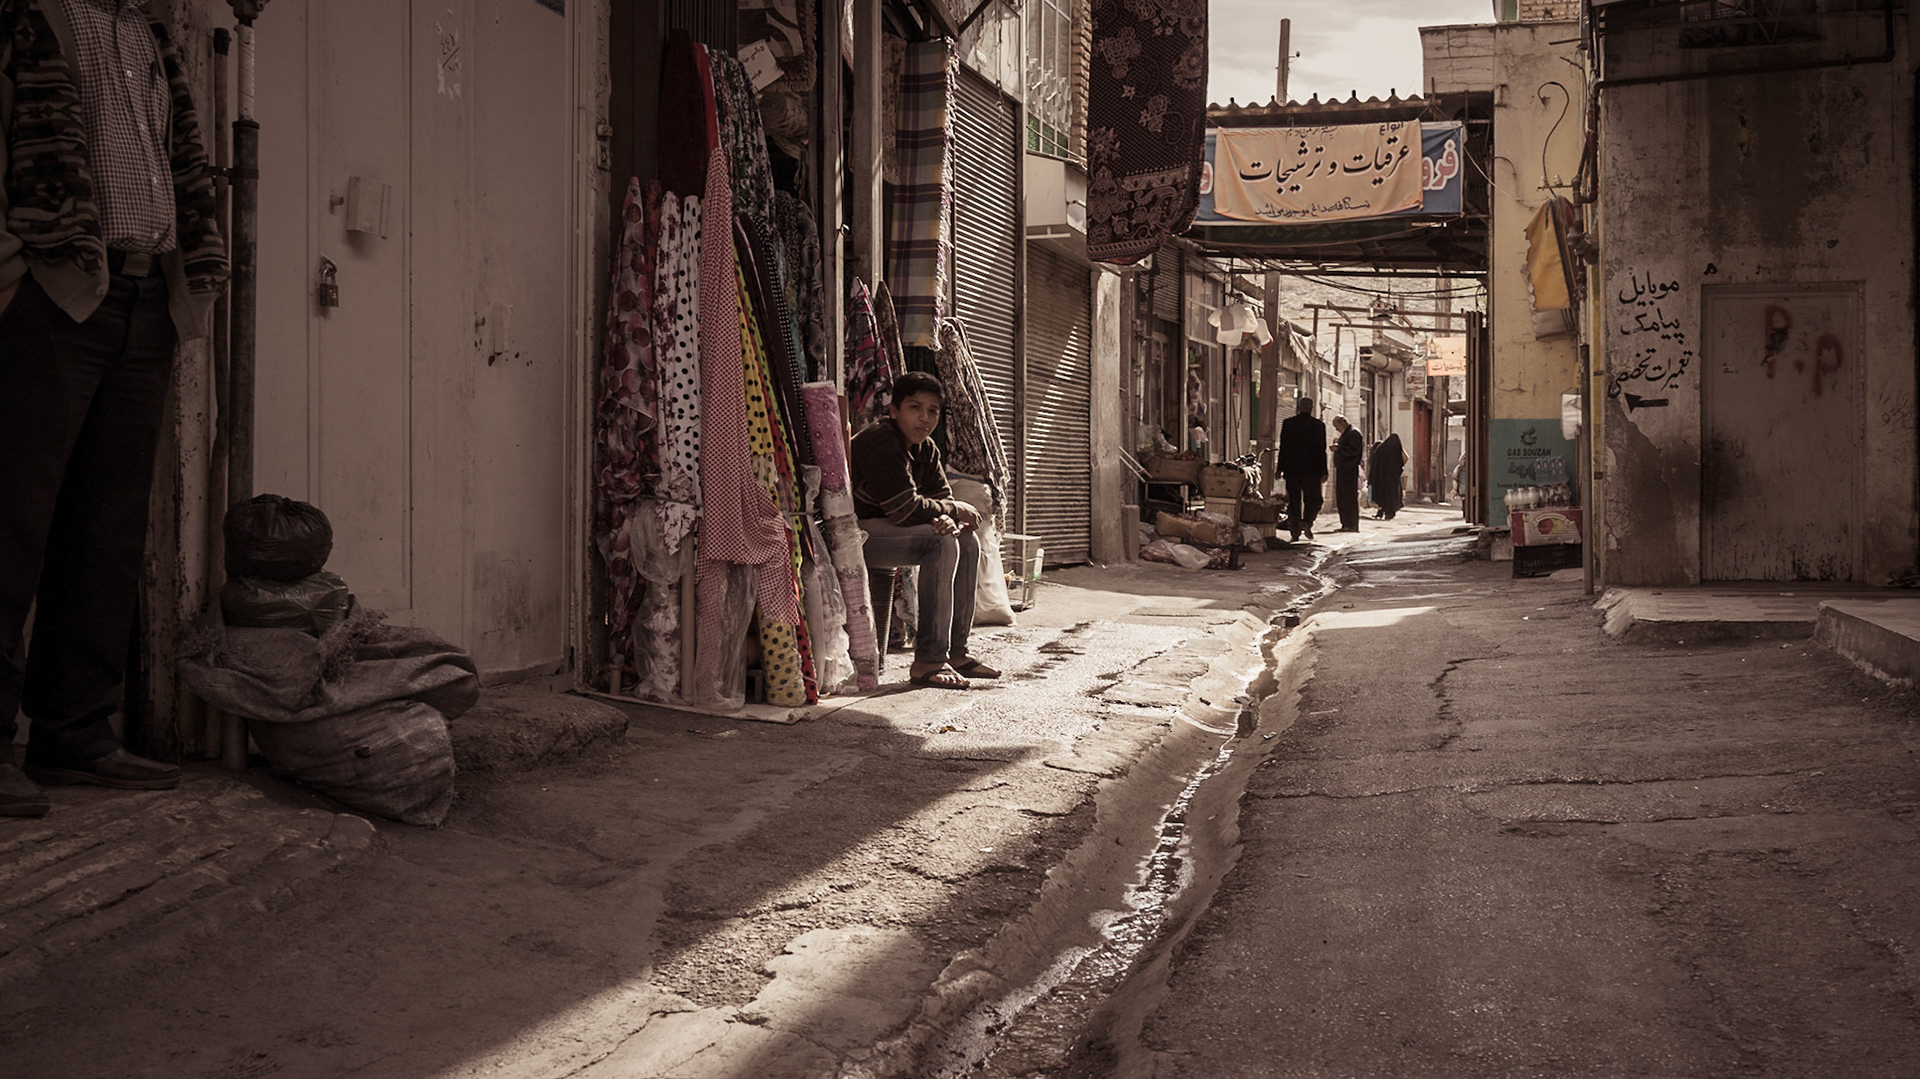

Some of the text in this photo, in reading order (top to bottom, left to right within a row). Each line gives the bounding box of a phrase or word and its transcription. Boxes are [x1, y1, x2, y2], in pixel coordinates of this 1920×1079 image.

[1239, 140, 1324, 195] ترشیجات
[1326, 159, 1337, 177] و
[1343, 136, 1411, 187] عرقیات
[1286, 207, 1310, 218] موجود
[1311, 202, 1327, 217] داغ
[1327, 196, 1371, 212] نسکافه
[1619, 271, 1679, 306] موبایل
[1620, 307, 1685, 345] پیامک
[1608, 347, 1693, 399] تعمیرات تخصصی
[1507, 448, 1552, 456] GAS SOUZAN
